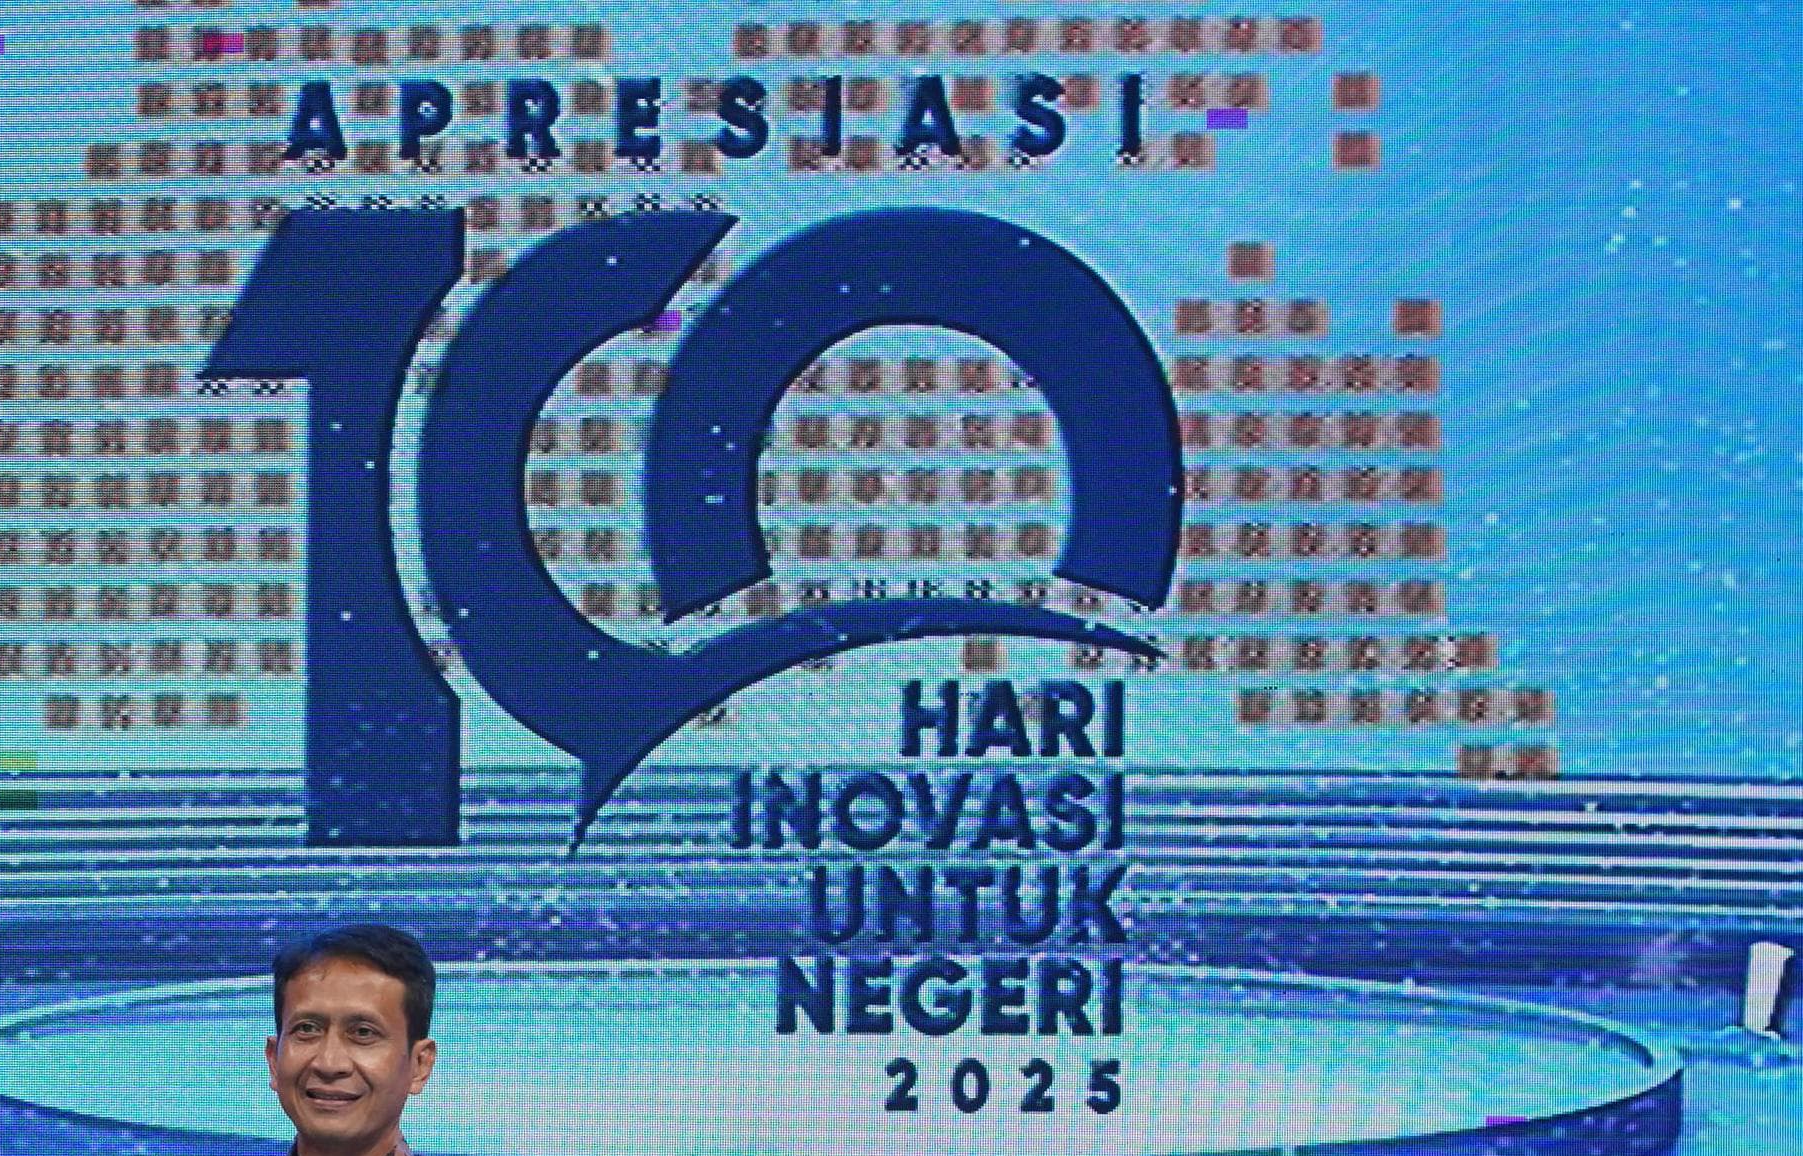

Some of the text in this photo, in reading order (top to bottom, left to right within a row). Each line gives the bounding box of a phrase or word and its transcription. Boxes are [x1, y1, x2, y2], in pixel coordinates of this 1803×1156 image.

[285, 74, 1146, 161] APRESIASI
[899, 679, 1125, 758] HARI
[730, 770, 1126, 853] INOVASI
[807, 863, 1127, 945] UNTUK
[776, 955, 1124, 1037] NEGERI
[884, 1056, 1123, 1115] 2025
